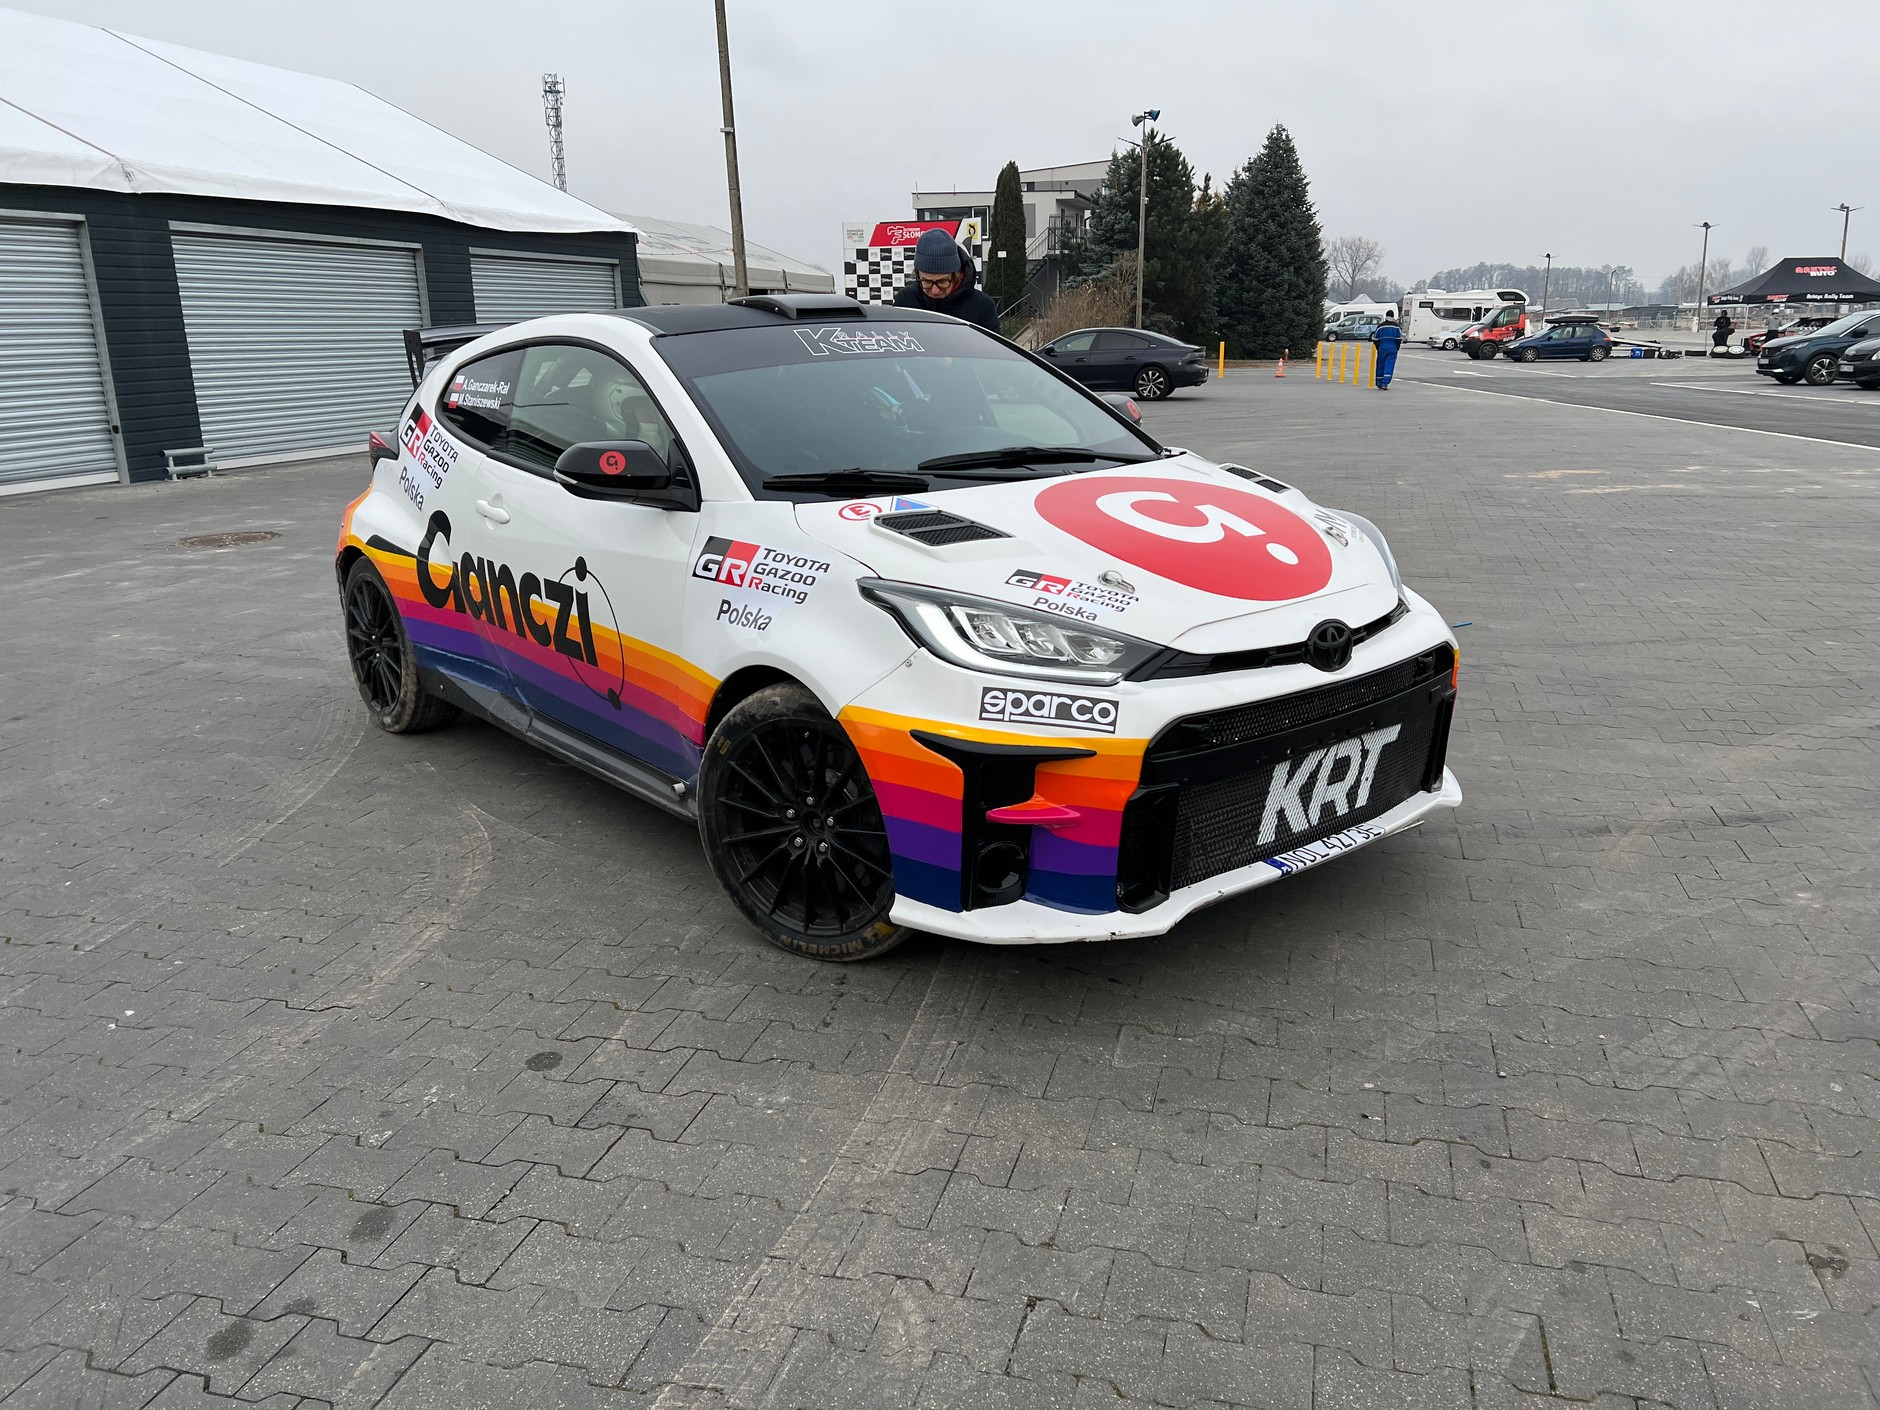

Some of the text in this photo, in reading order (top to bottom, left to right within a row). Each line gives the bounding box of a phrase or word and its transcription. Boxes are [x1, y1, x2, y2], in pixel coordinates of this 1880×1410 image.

[834, 338, 925, 352] TEAM
[837, 331, 911, 339] RALLY
[401, 419, 423, 456] GR
[430, 425, 459, 462] TOYOTA
[418, 452, 443, 489] Racing
[423, 439, 450, 473] GAZOO
[399, 466, 425, 511] Polska
[695, 553, 748, 584] GR
[753, 562, 817, 586] GAZOO
[762, 548, 830, 573] TOYOTA
[416, 509, 599, 667] Ganczi
[748, 576, 808, 604] Racing
[1008, 575, 1067, 594] GR
[1071, 587, 1131, 606] GAZOO
[1075, 581, 1139, 602] TOYOTA
[716, 599, 773, 631] Polska
[1033, 597, 1098, 621] Polska
[1066, 592, 1125, 612] Racing
[983, 690, 1116, 724] sparco
[1257, 723, 1402, 845] KRT
